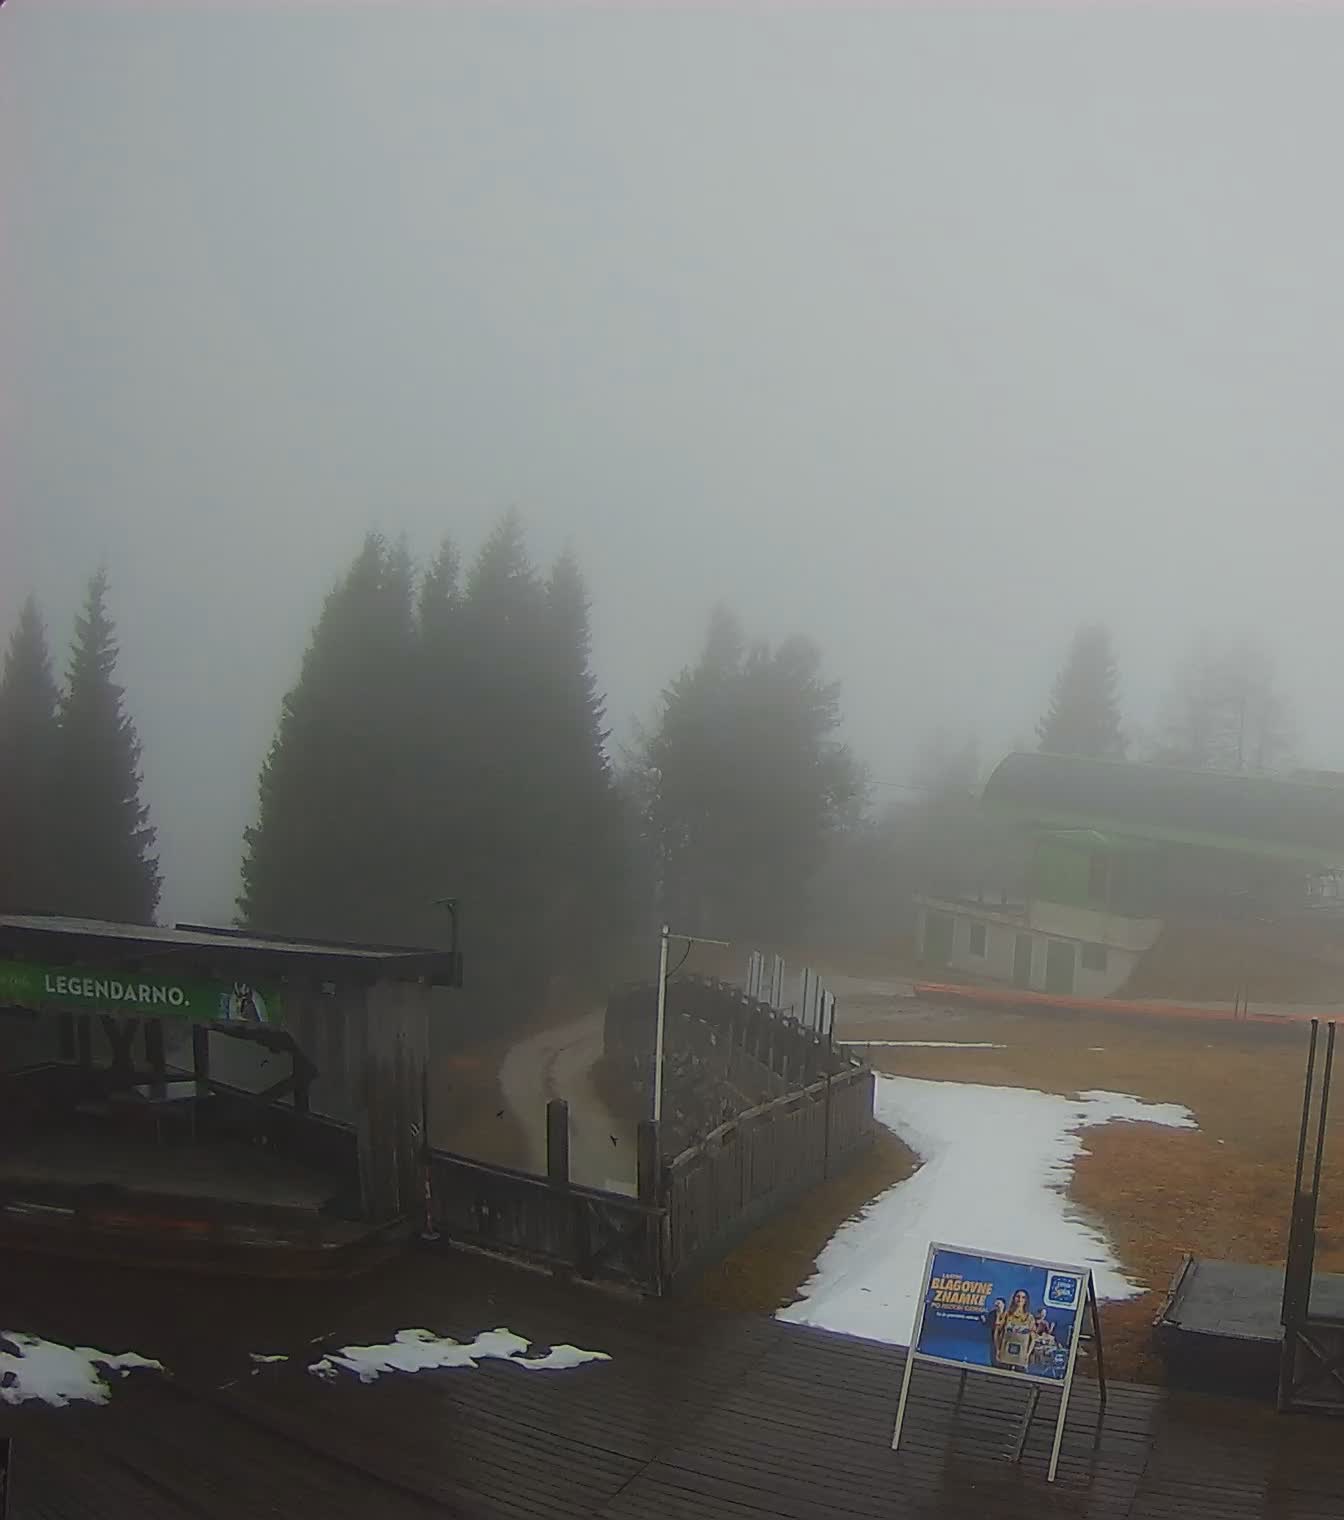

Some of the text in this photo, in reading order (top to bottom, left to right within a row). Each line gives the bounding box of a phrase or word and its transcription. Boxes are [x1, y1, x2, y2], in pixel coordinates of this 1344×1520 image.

[45, 974, 190, 1006] LEGENDARNO.
[931, 1277, 993, 1295] BLAGOVNE
[933, 1290, 987, 1306] ZNAMKE
